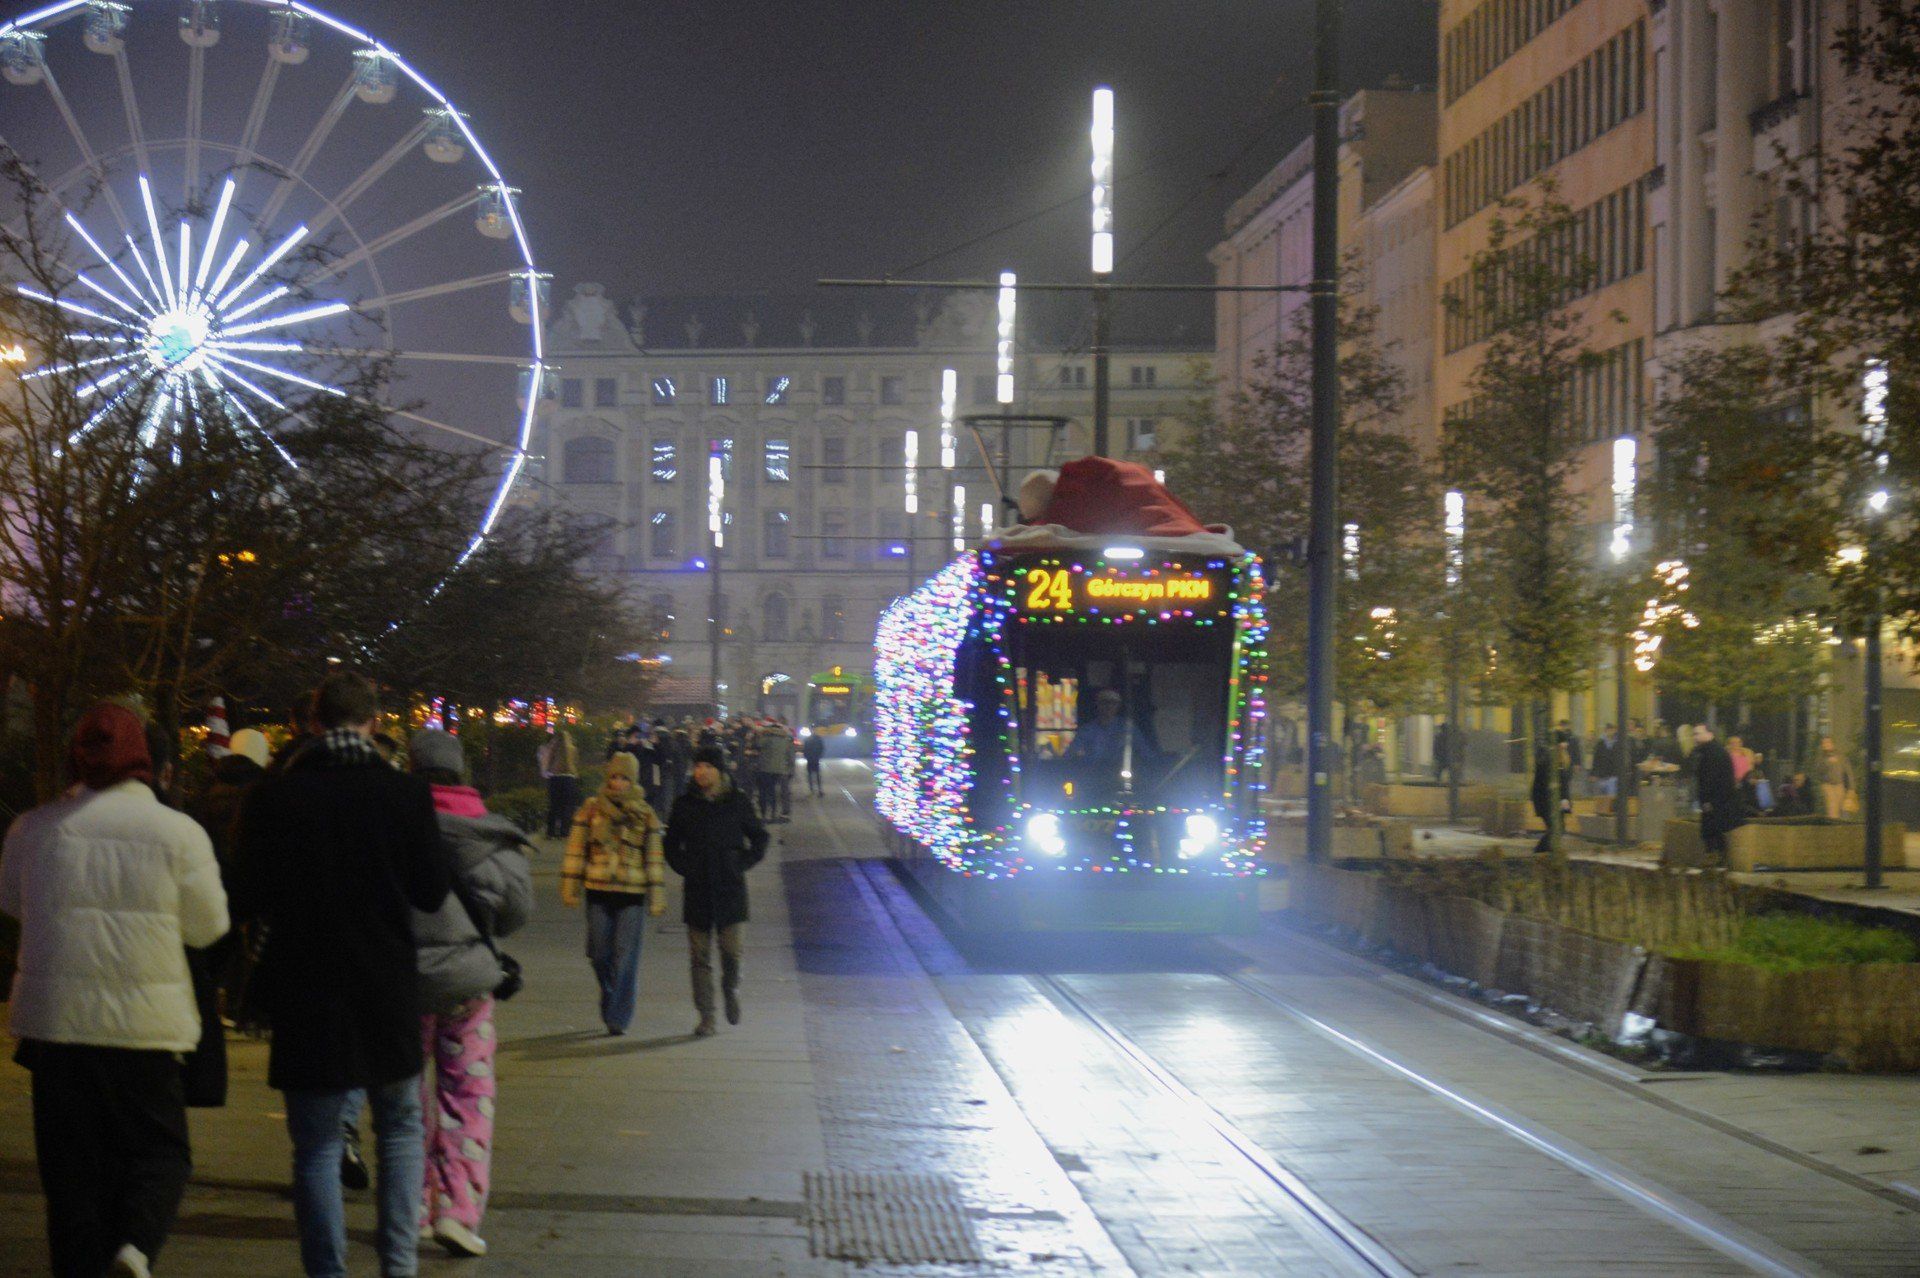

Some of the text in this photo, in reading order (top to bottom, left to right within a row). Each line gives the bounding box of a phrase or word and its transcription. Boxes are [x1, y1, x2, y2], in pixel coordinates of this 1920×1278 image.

[1028, 569, 1209, 609] 24 Górczyn PKM
